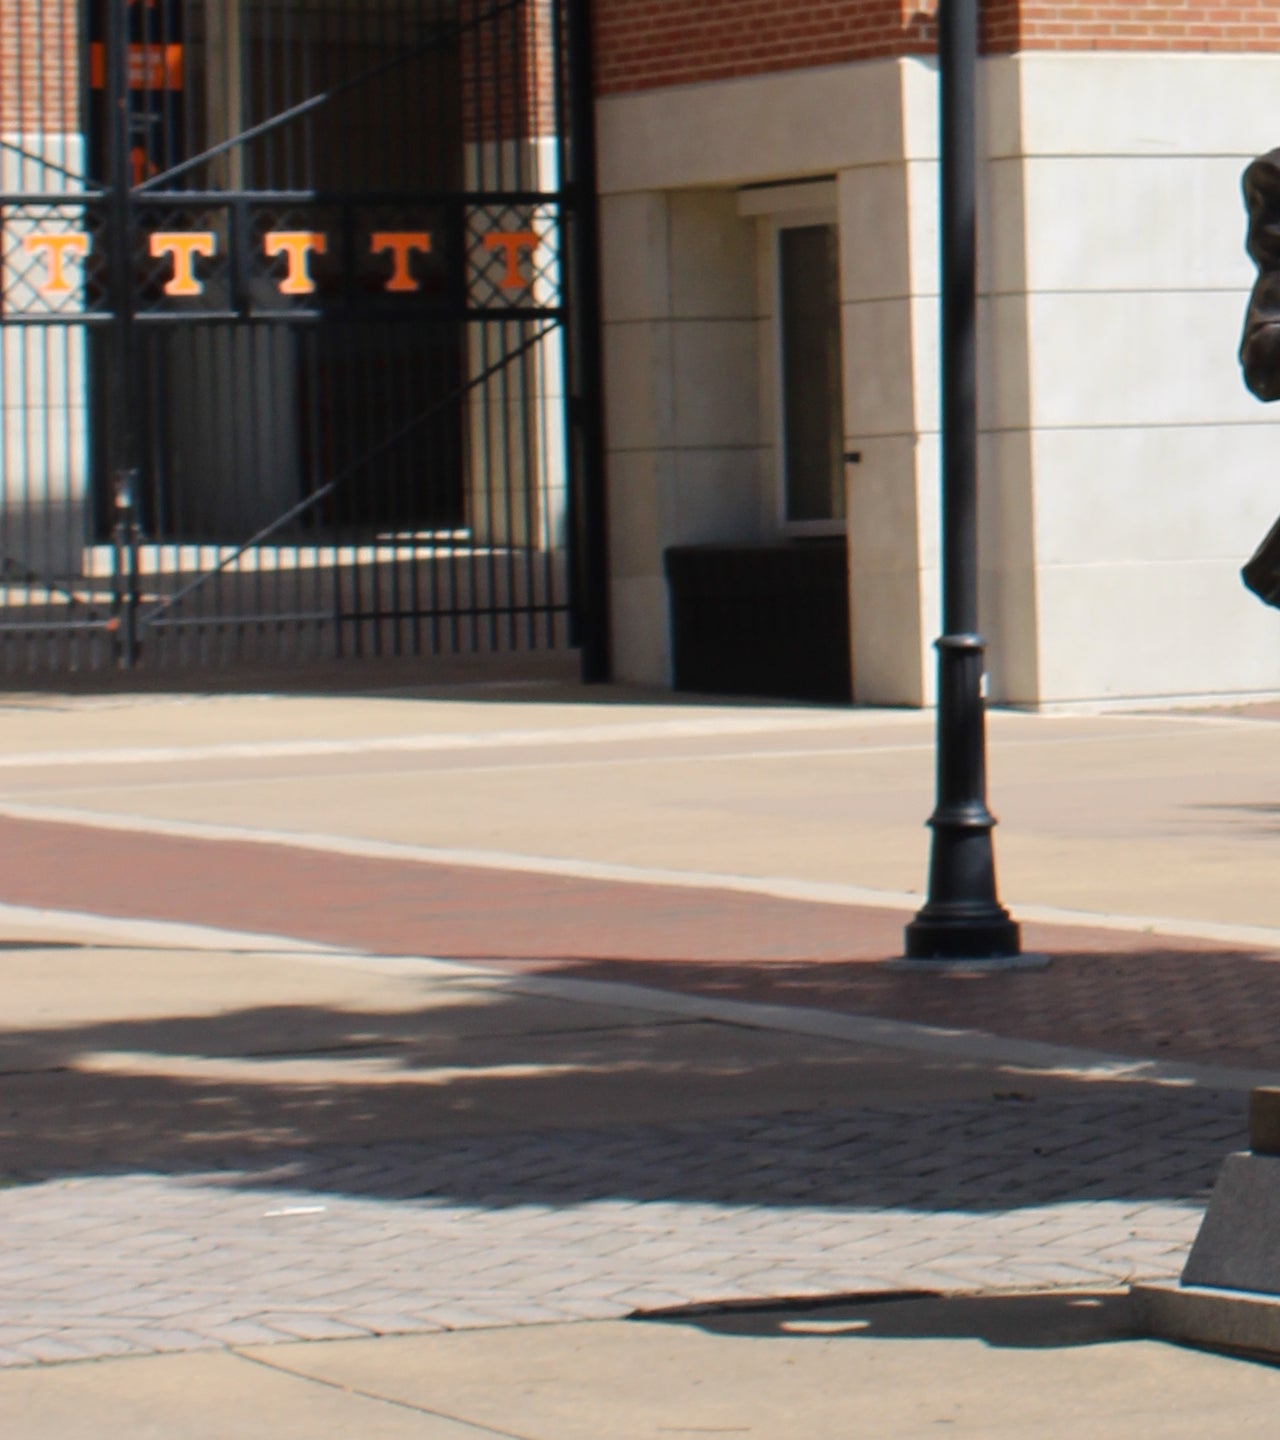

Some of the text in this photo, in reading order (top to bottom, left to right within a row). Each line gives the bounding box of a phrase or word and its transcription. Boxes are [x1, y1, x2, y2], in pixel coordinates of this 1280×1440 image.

[22, 231, 538, 295] T T T T T
